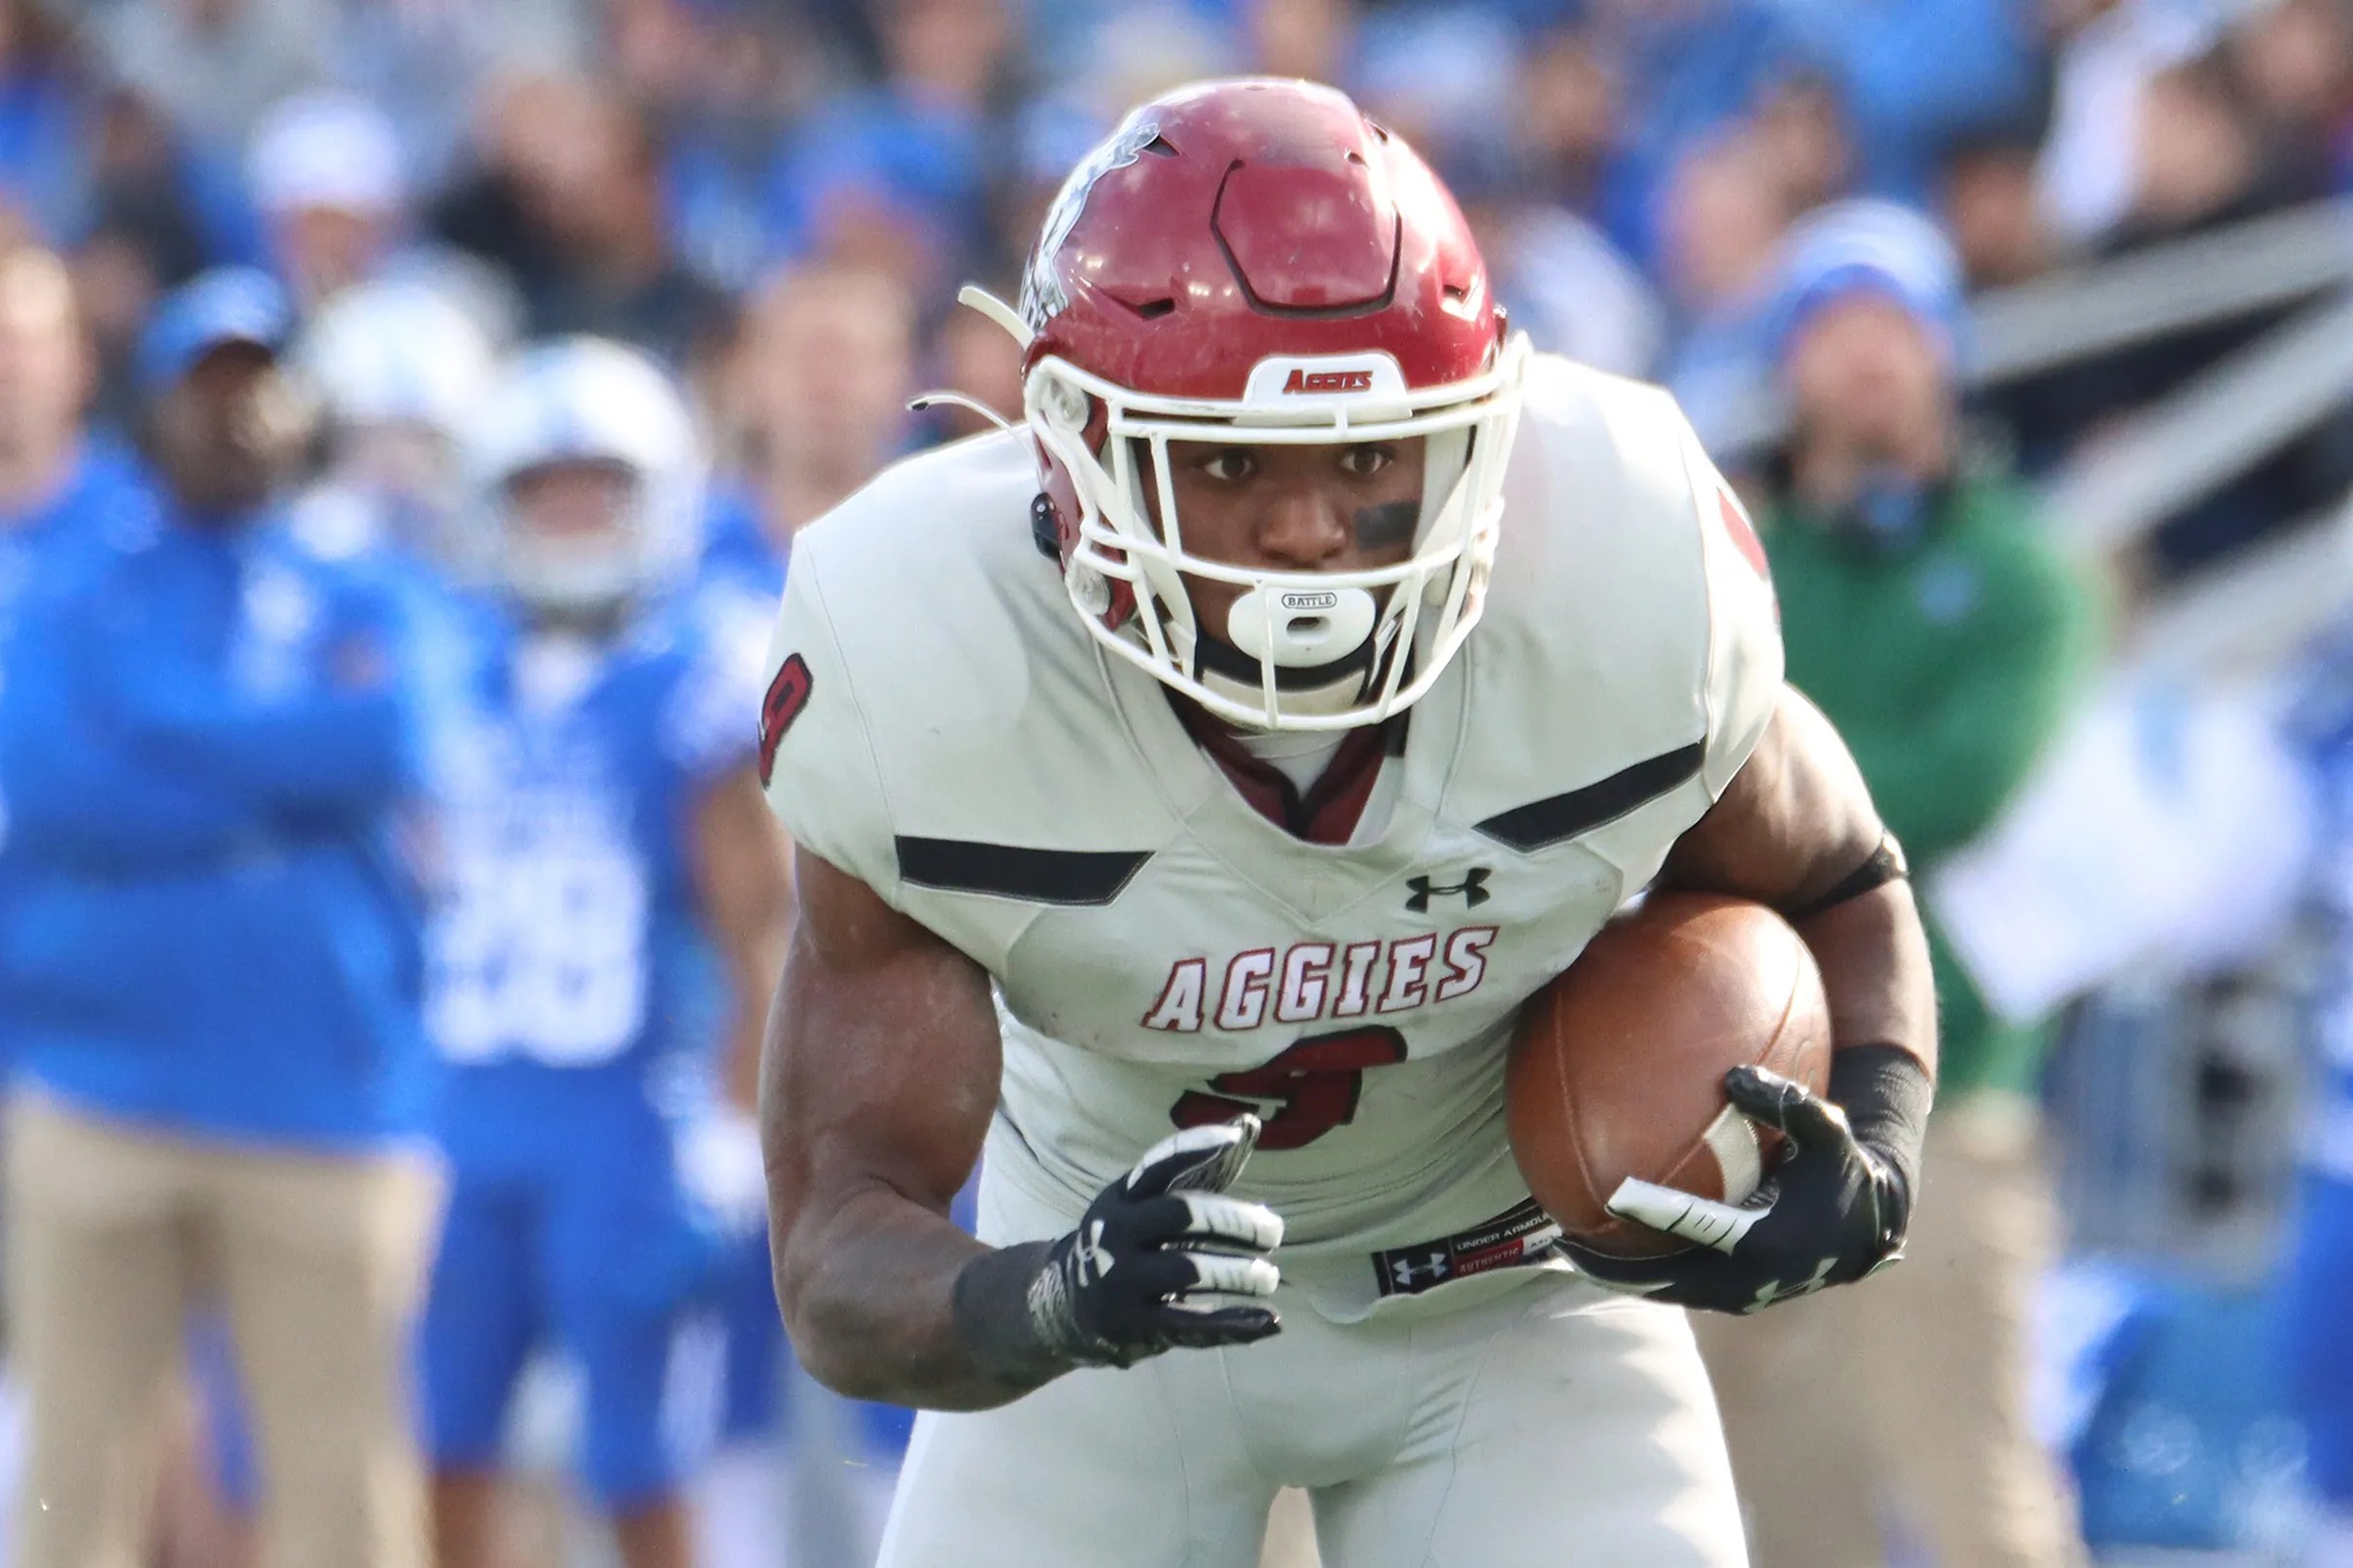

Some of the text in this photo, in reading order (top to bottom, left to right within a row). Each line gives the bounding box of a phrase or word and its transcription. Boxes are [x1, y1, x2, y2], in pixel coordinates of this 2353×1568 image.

[1287, 595, 1333, 607] BATTLE
[1141, 925, 1500, 1032] AGGIES
[1457, 1212, 1550, 1251] UNDER ARMOU
[1459, 1245, 1521, 1272] AUTHENTIC
